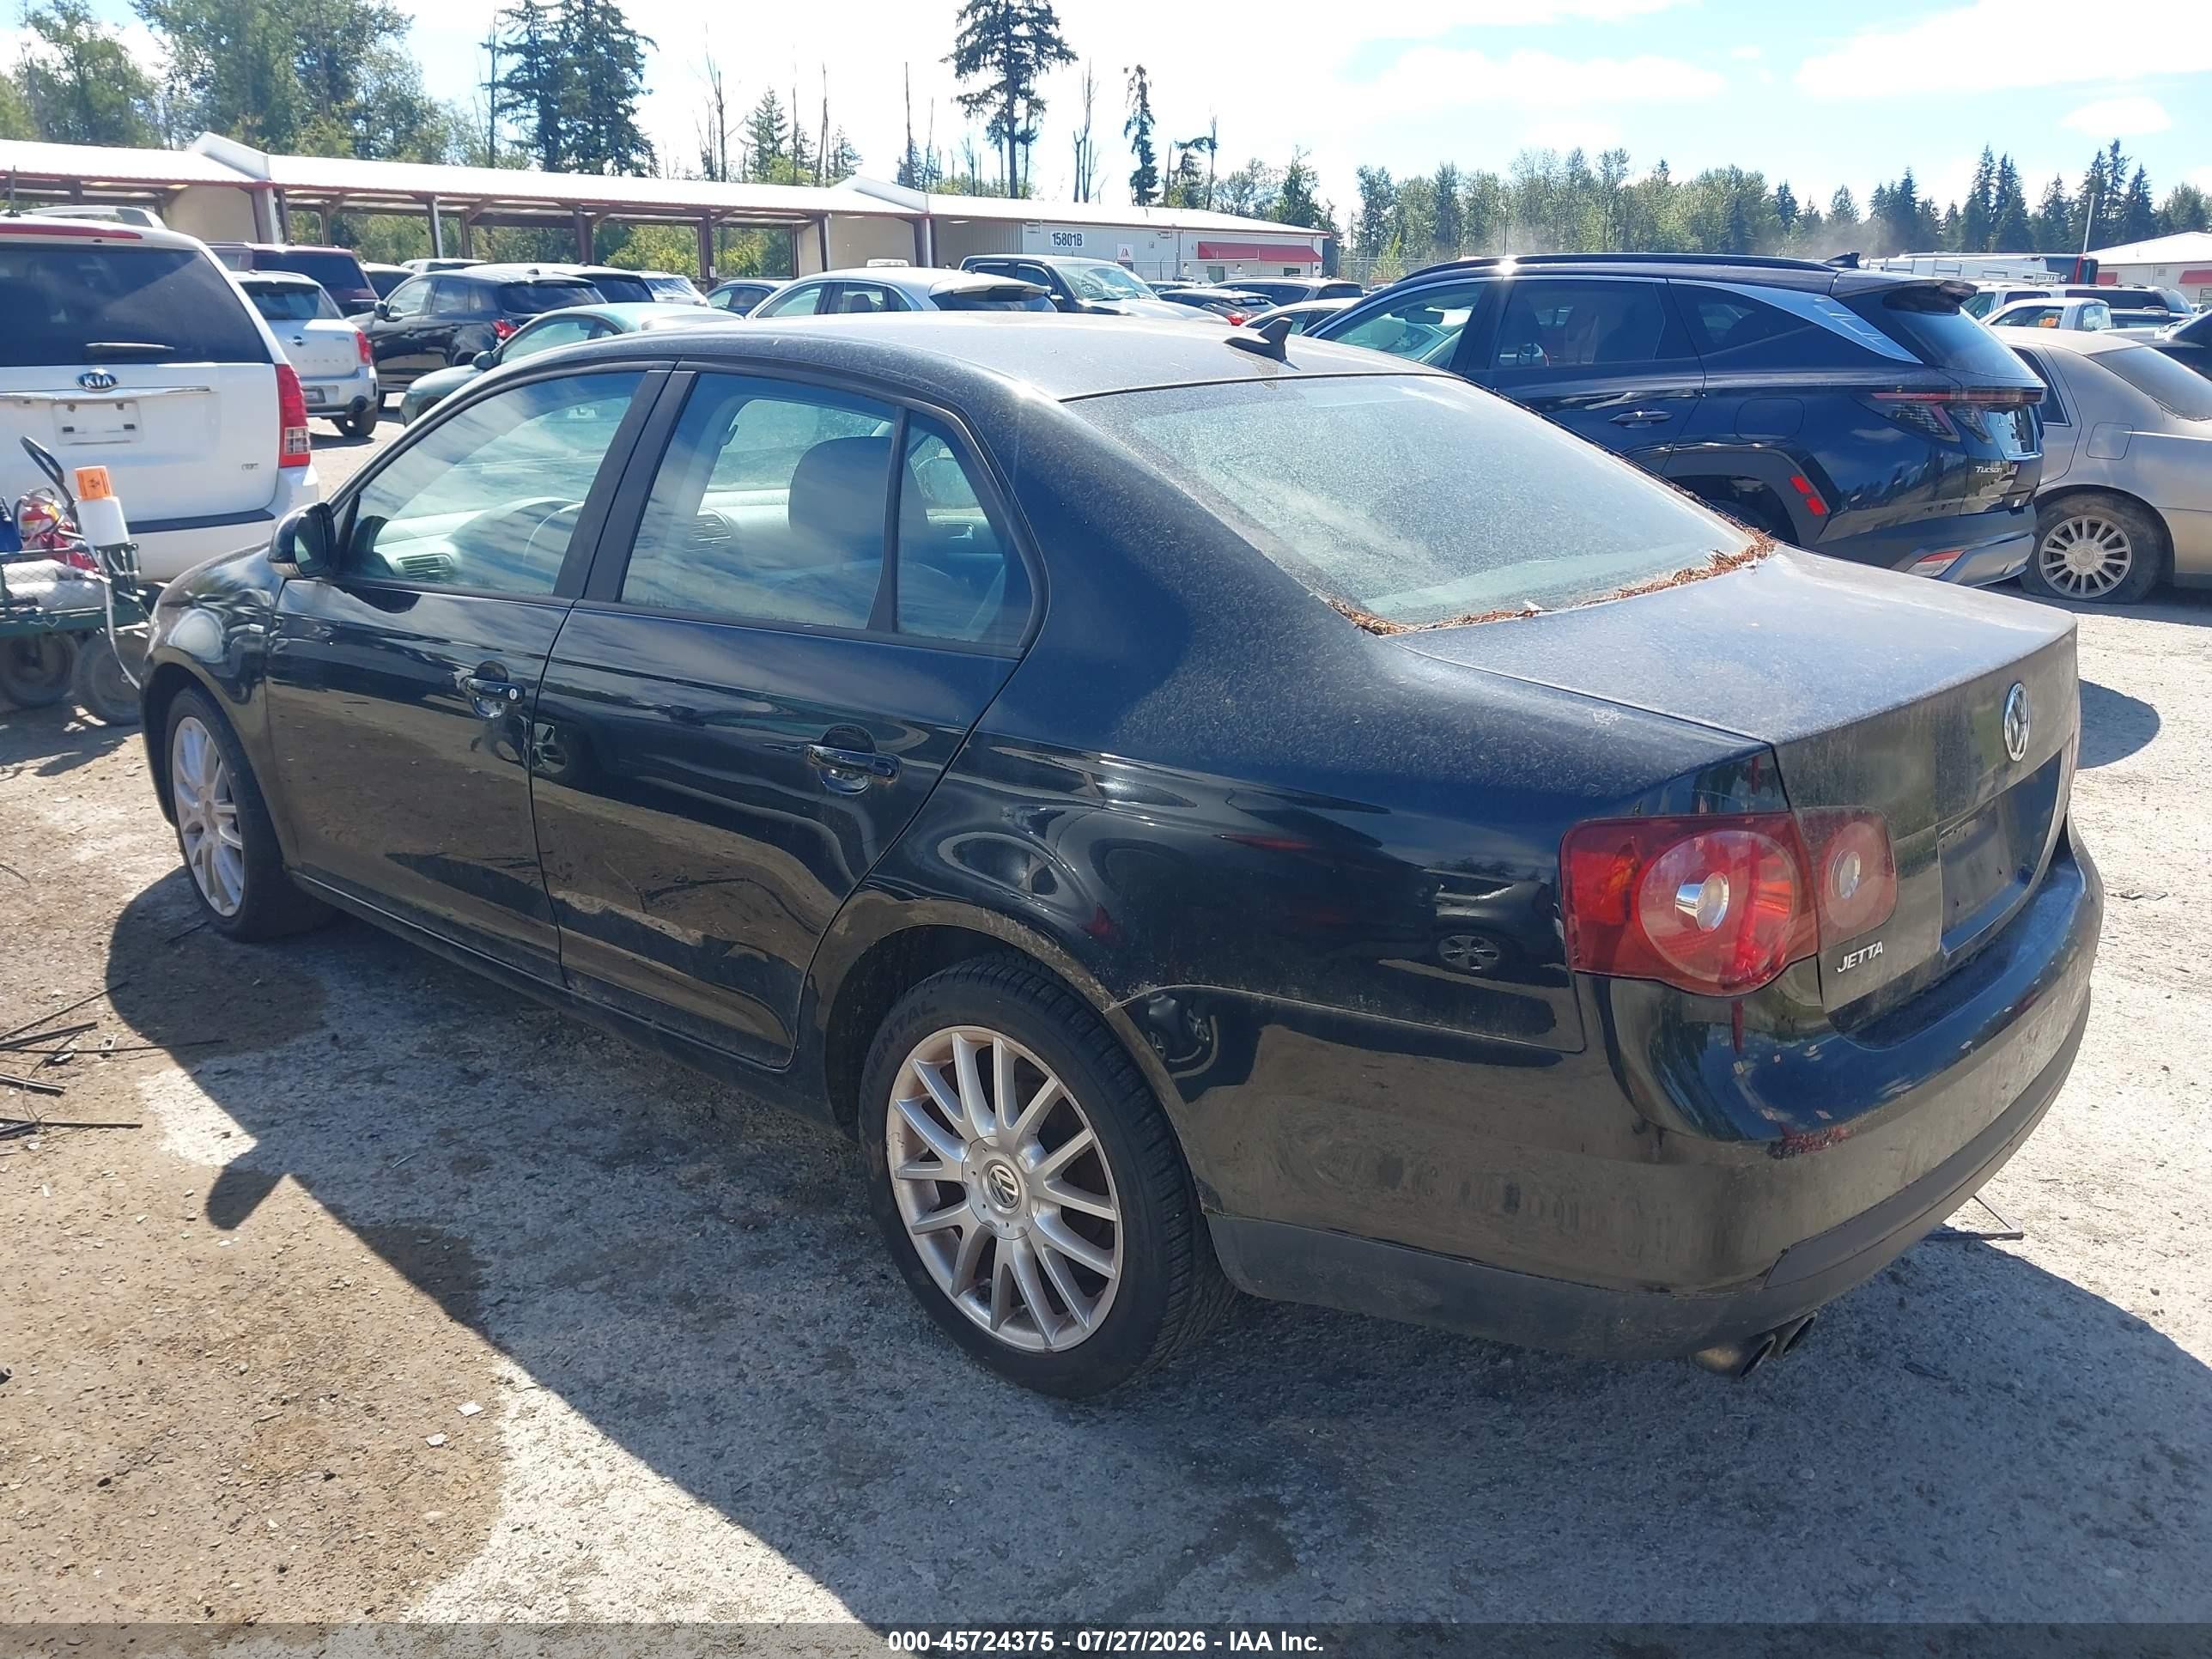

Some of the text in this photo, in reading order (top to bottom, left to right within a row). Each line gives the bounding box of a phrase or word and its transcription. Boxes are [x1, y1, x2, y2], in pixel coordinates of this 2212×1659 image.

[1052, 233, 1083, 246] 15801B
[83, 374, 112, 387] KIA
[1836, 940, 1883, 973] JETTA
